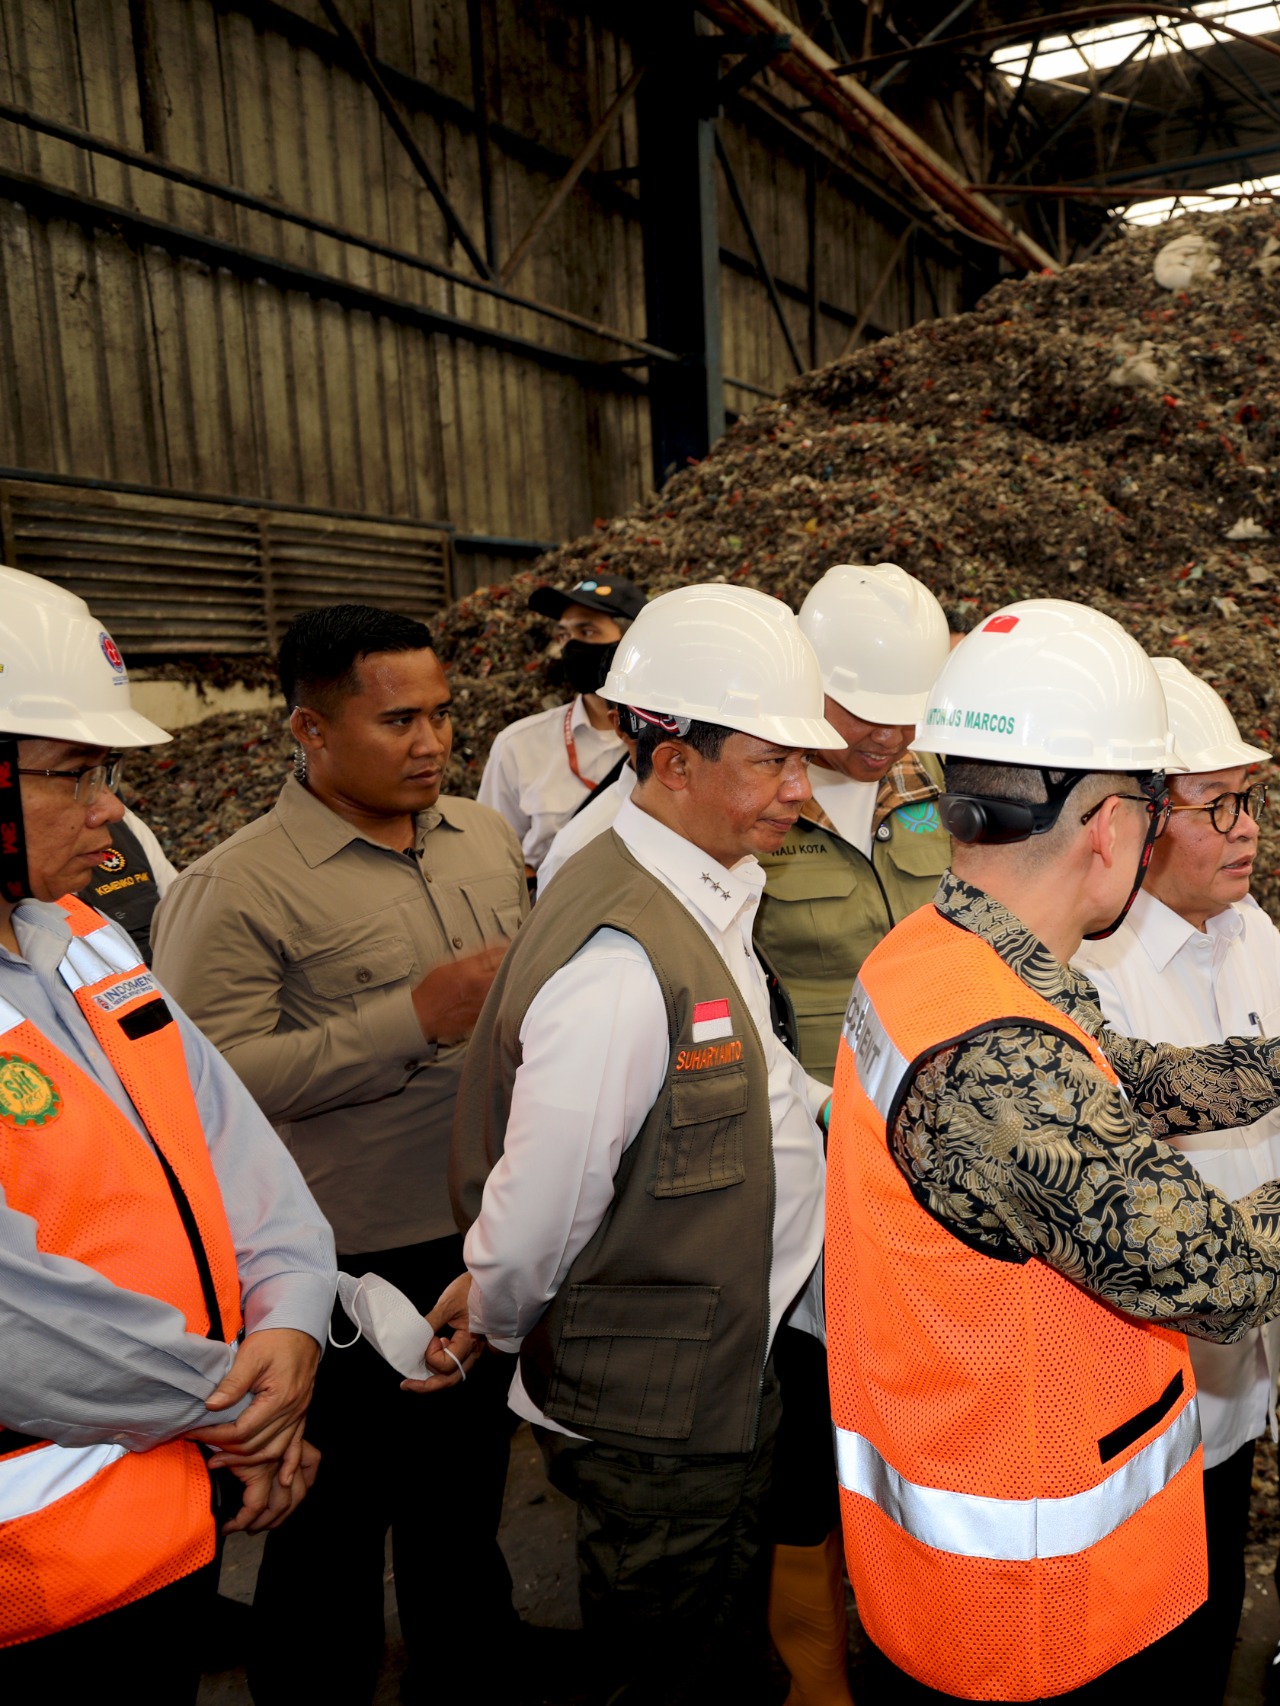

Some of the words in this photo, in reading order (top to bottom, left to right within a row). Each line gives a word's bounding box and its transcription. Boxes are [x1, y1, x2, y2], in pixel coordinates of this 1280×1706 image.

[964, 710, 1015, 735] MARCOS
[1, 822, 18, 854] 3M
[799, 844, 828, 854] KOTA
[676, 1040, 742, 1071] SUHARYANTO
